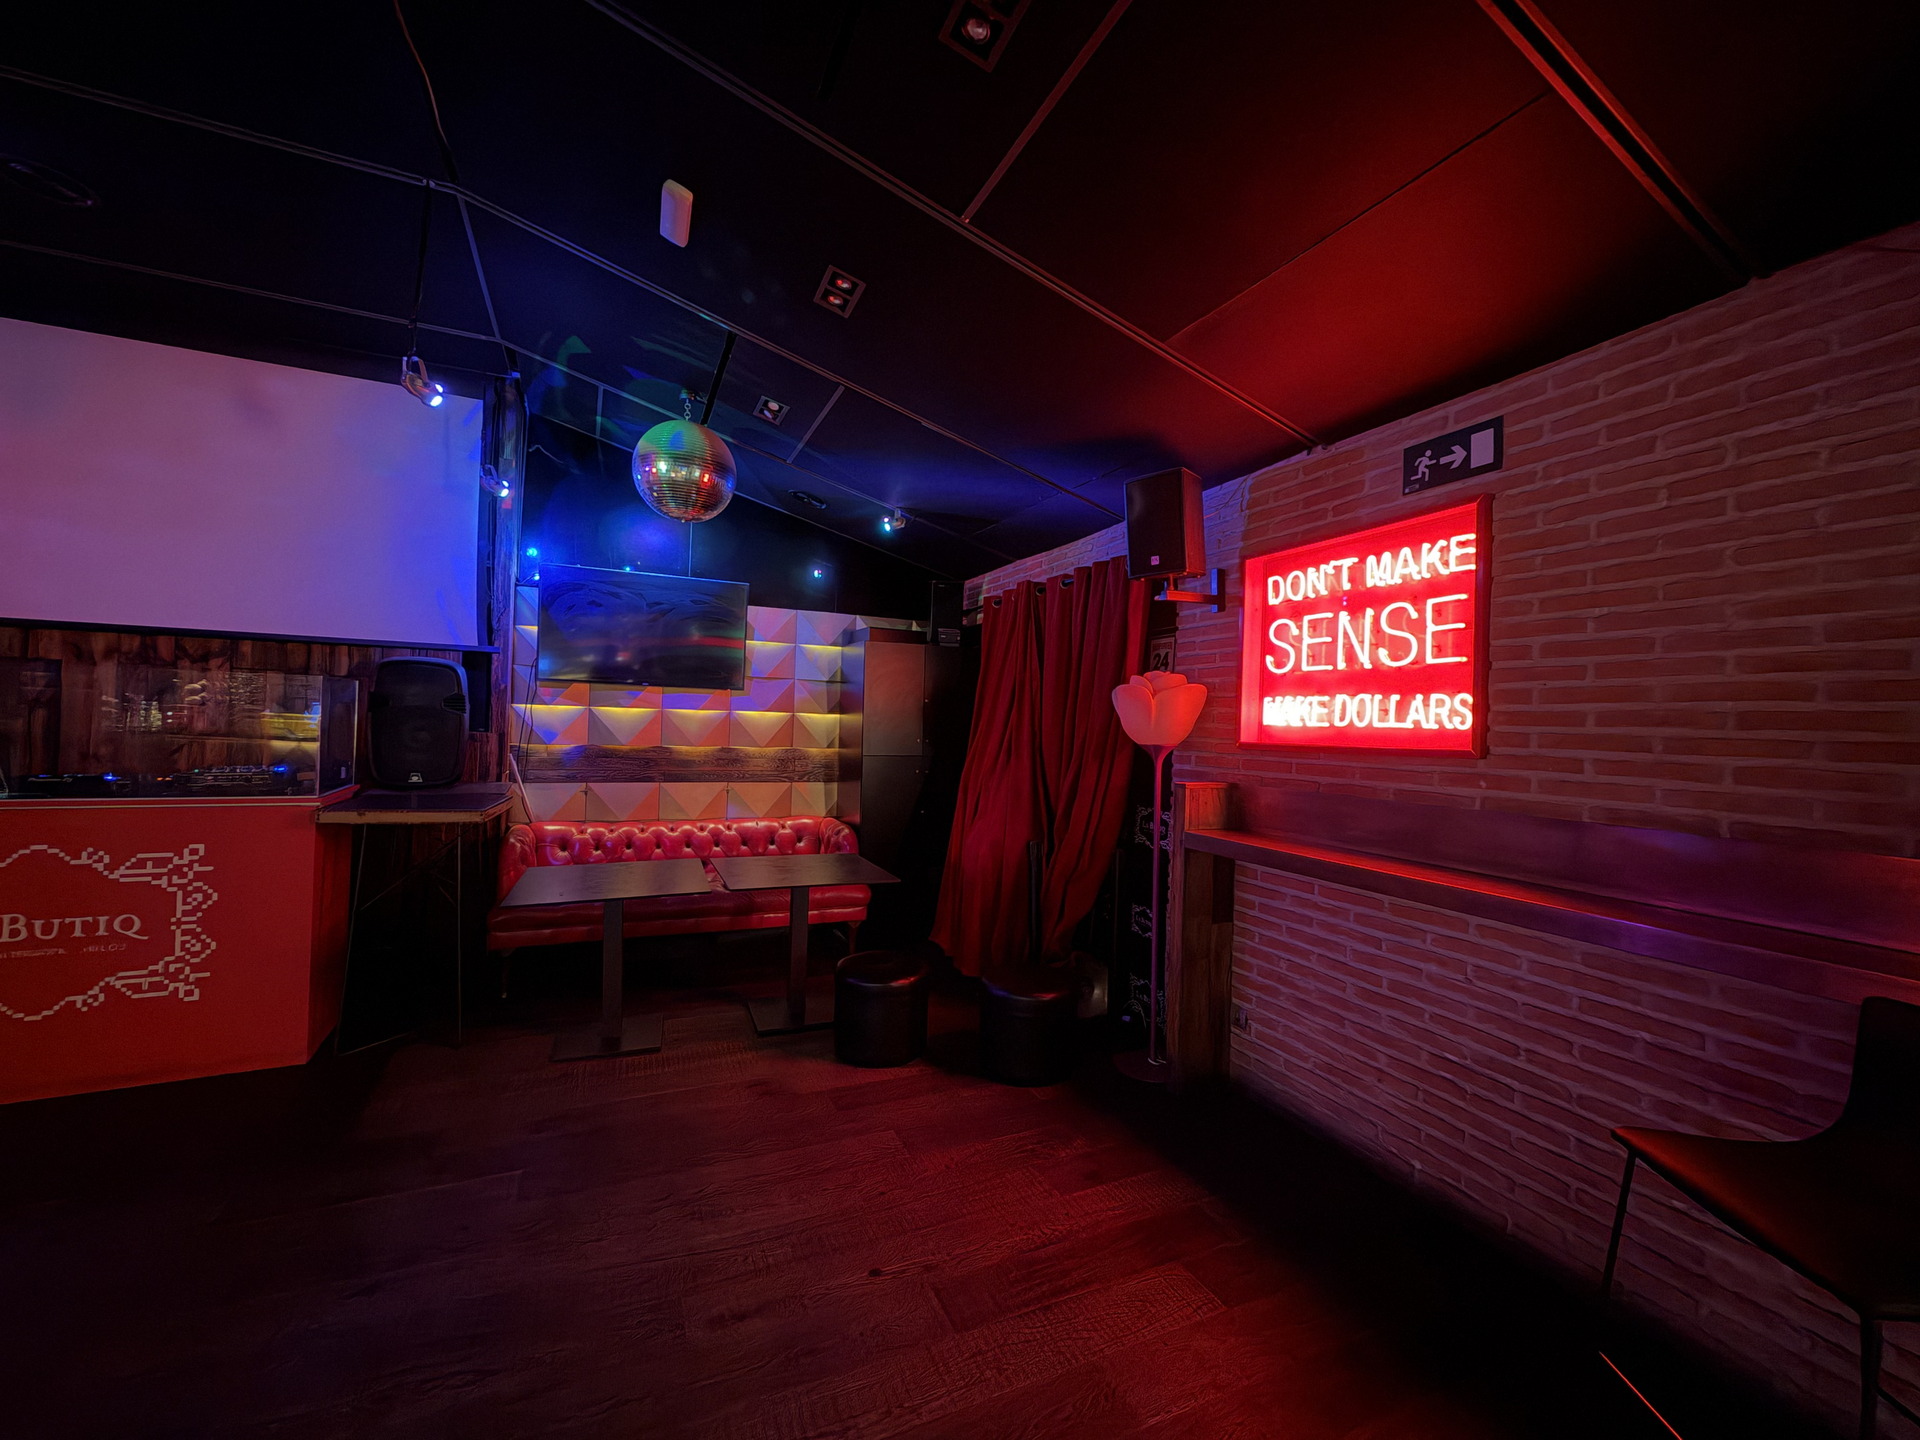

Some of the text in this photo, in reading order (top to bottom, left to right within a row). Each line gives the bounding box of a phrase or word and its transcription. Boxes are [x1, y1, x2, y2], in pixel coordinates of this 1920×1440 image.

[1267, 533, 1477, 606] DON'T MAKE
[1265, 593, 1469, 674] SENSE
[1334, 692, 1474, 731] DOLLARS
